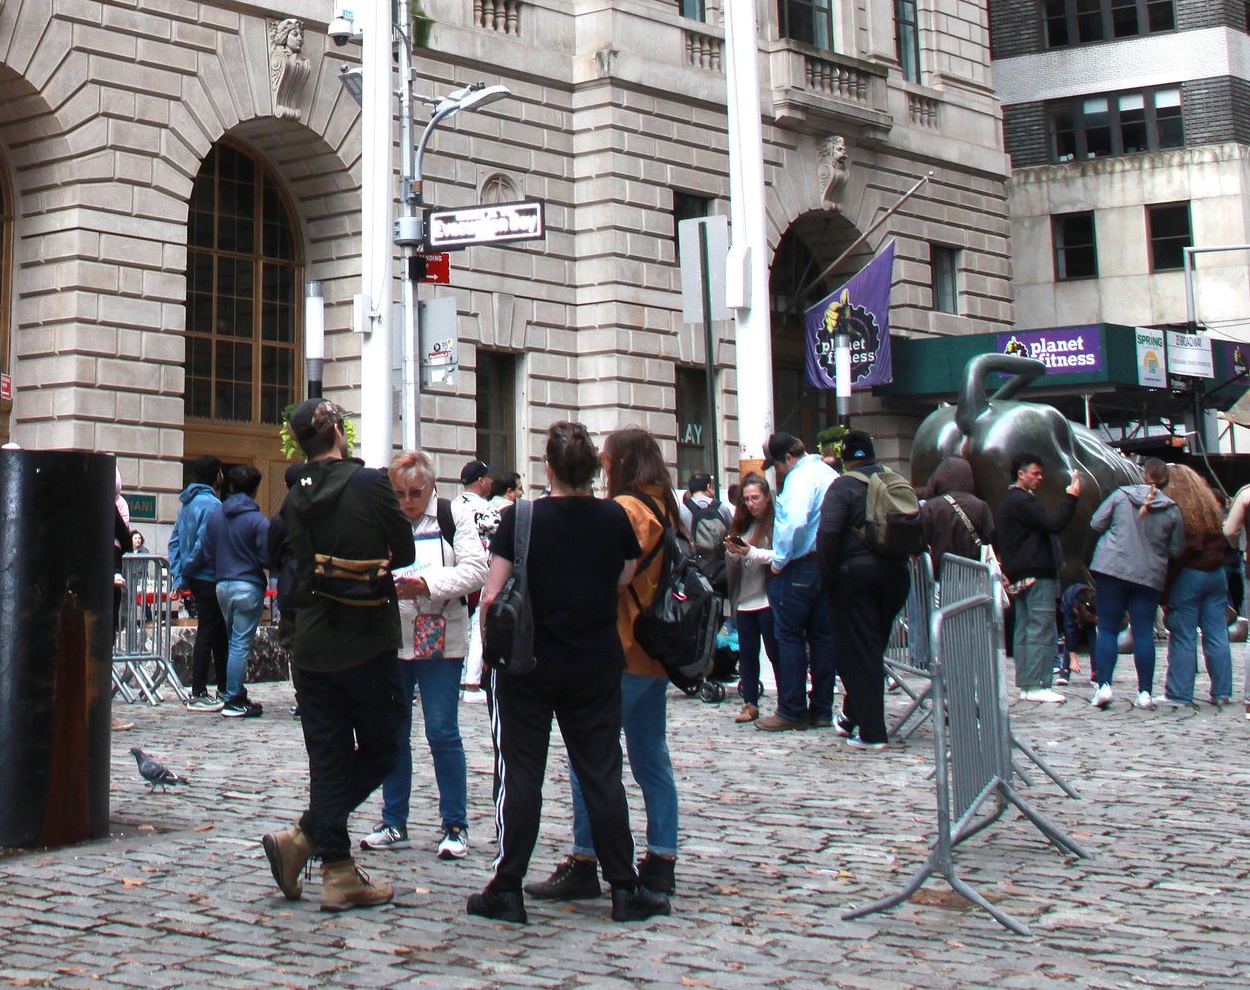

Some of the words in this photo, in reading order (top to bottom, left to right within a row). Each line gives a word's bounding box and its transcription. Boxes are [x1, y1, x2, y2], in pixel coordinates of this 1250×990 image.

[821, 338, 866, 355] plet
[1030, 336, 1084, 358] planet
[1137, 334, 1163, 348] SPRING
[827, 351, 875, 364] fess
[1038, 354, 1096, 368] fitness
[130, 501, 153, 512] IANI
